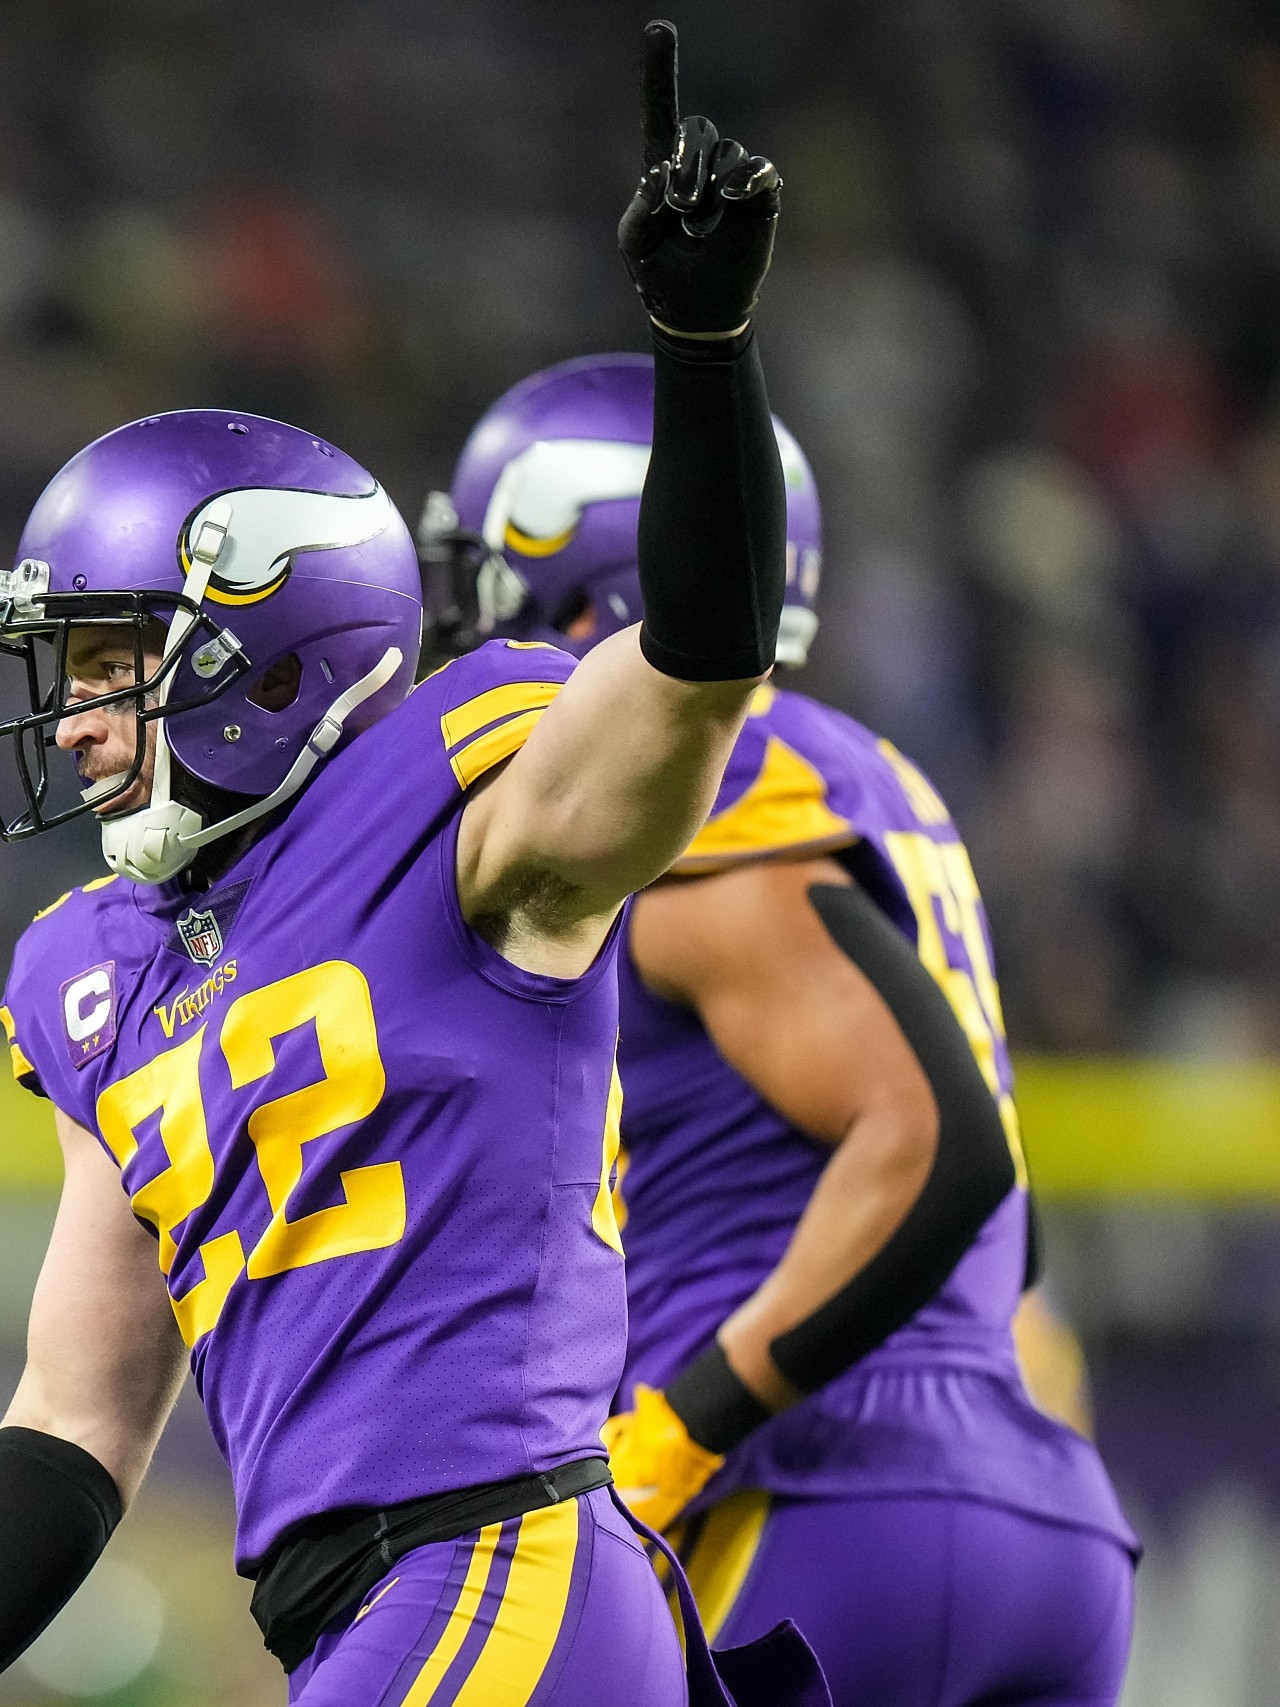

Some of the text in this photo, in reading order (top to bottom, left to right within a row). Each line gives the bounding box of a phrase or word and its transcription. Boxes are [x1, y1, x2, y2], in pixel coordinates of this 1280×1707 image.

[190, 932, 218, 956] NFL
[64, 969, 111, 1042] C
[96, 959, 407, 1349] 22
